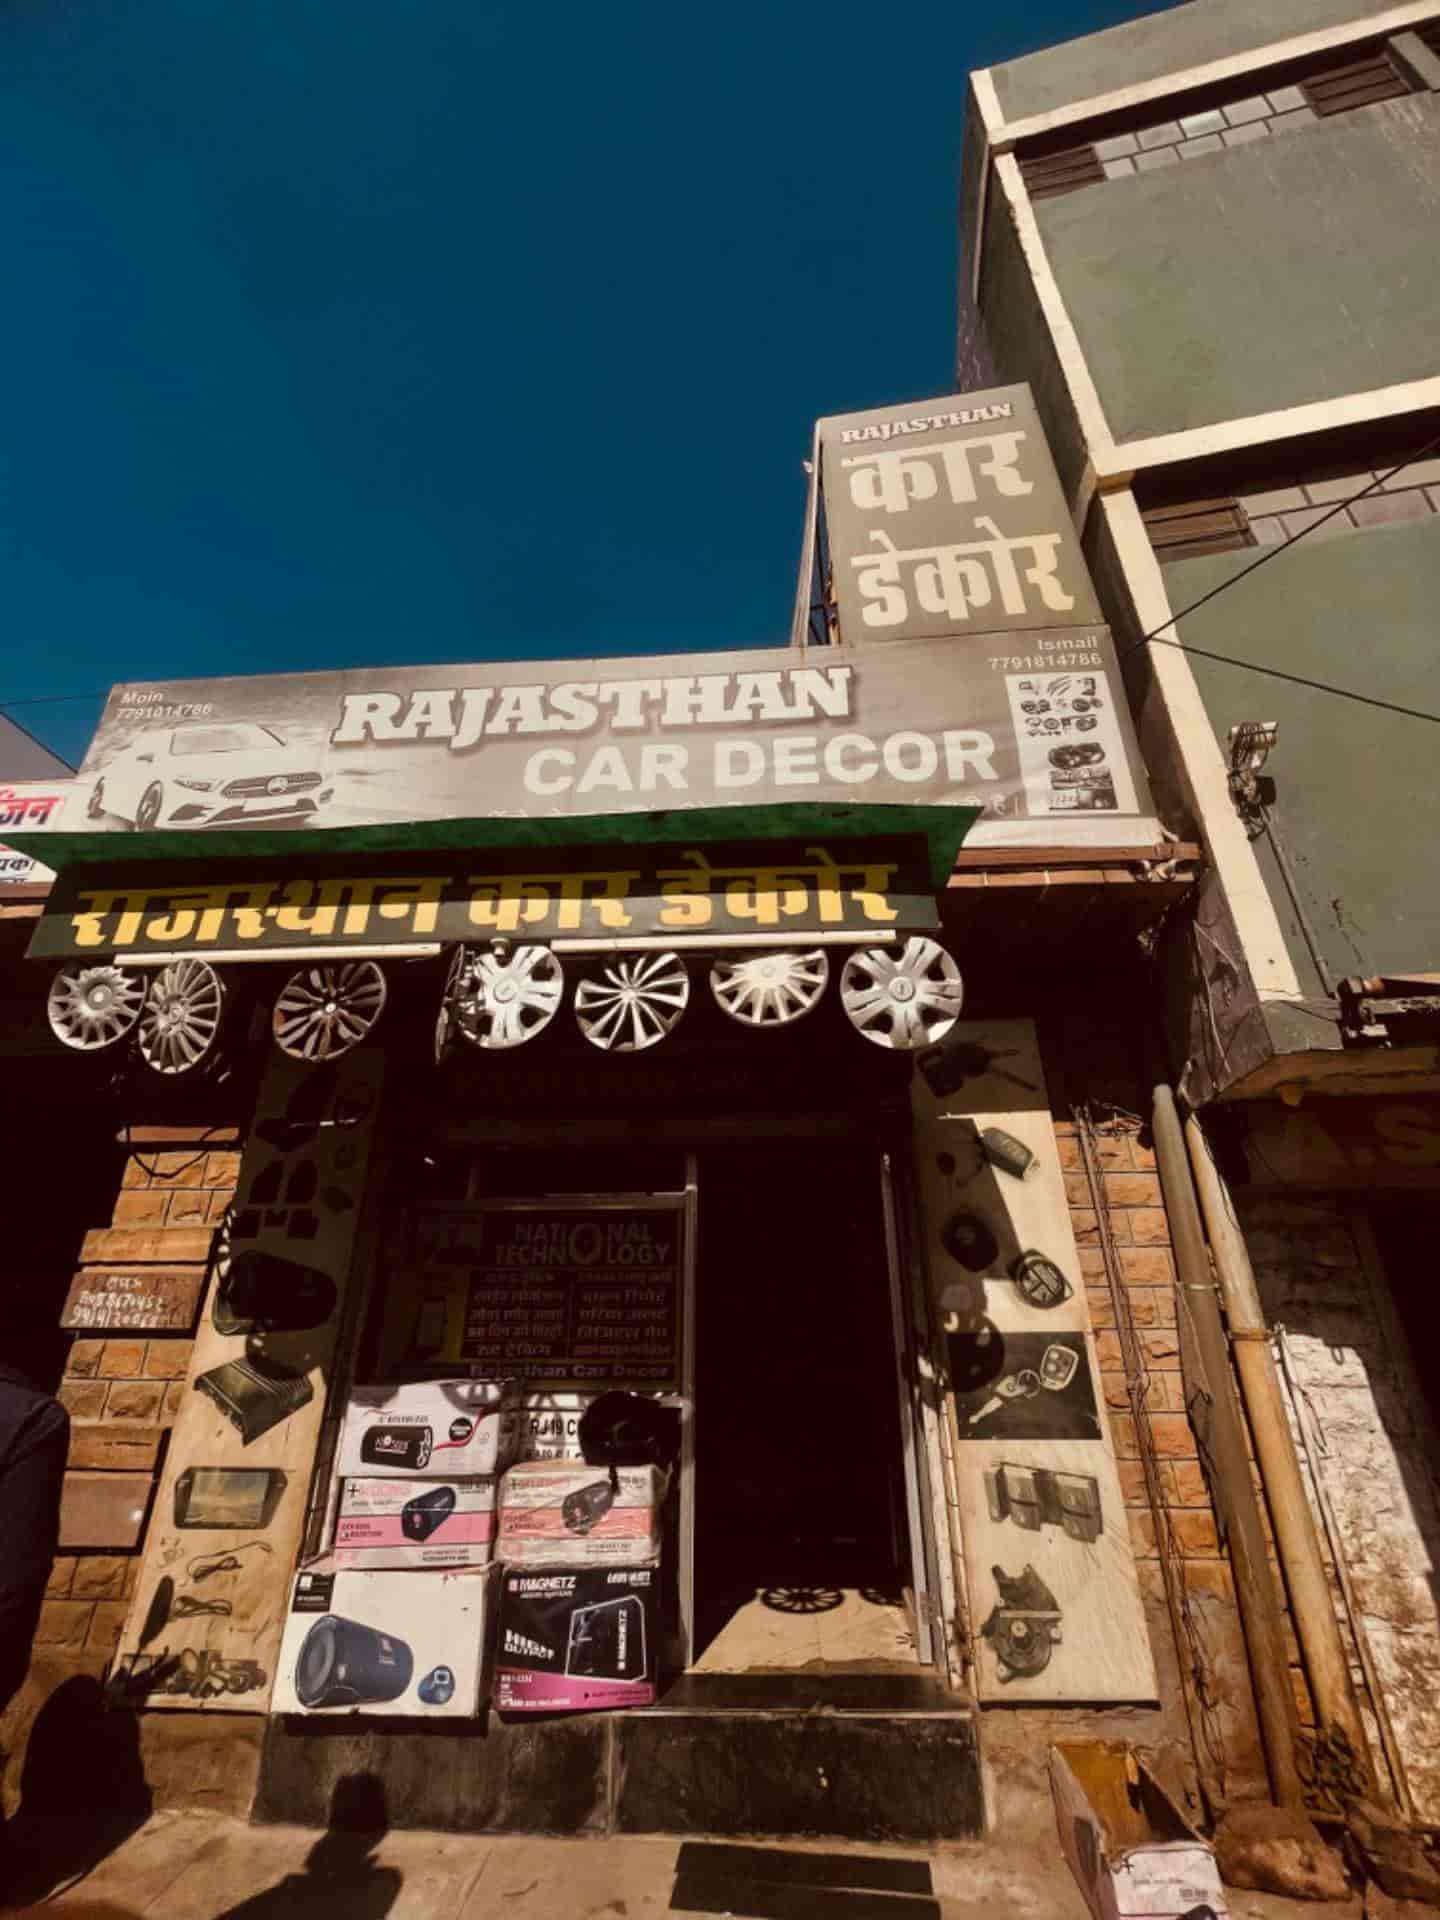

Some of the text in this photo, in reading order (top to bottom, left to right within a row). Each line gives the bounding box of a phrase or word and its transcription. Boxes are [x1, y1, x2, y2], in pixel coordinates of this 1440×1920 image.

[841, 402, 1013, 444] RAJASTHAN
[841, 430, 1034, 513] कार
[851, 515, 1075, 628] डेकोर
[987, 652, 1102, 671] 7791814786
[1038, 635, 1098, 651] Ismail
[332, 666, 852, 752] RAJASTHAN
[523, 728, 1000, 795] CAR DECOR
[71, 847, 900, 947] राजस्थान कार डेकोर
